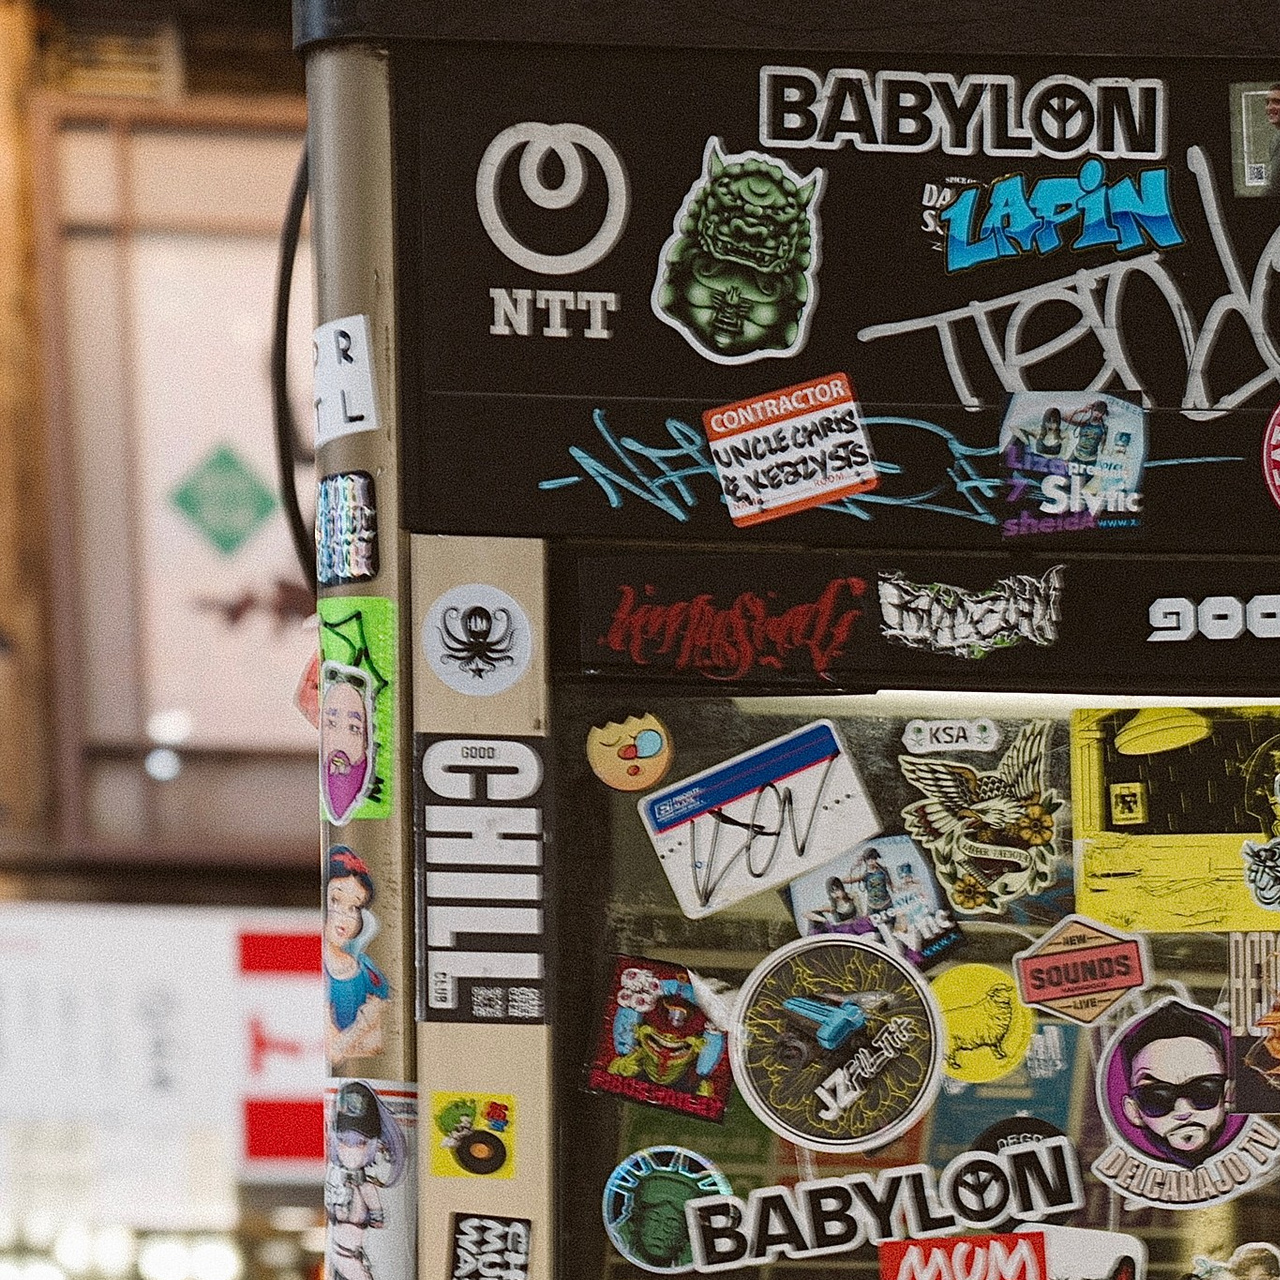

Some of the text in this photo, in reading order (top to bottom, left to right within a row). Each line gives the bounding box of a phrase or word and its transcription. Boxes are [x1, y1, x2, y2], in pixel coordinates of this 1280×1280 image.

[767, 70, 1158, 153] BABYLON
[940, 158, 1184, 273] LAPIN
[489, 288, 621, 340] NTT
[710, 379, 846, 433] CONTRACTOR
[461, 746, 495, 760] GOOD
[928, 725, 970, 745] KSA
[421, 738, 544, 1009] CHILL
[434, 971, 449, 1004] CLUB
[1029, 954, 1132, 991] SOUNDS
[1072, 997, 1098, 1011] LIVE
[1102, 1121, 1280, 1202] DELCARAJO TV
[697, 1145, 1076, 1267] BABYLON
